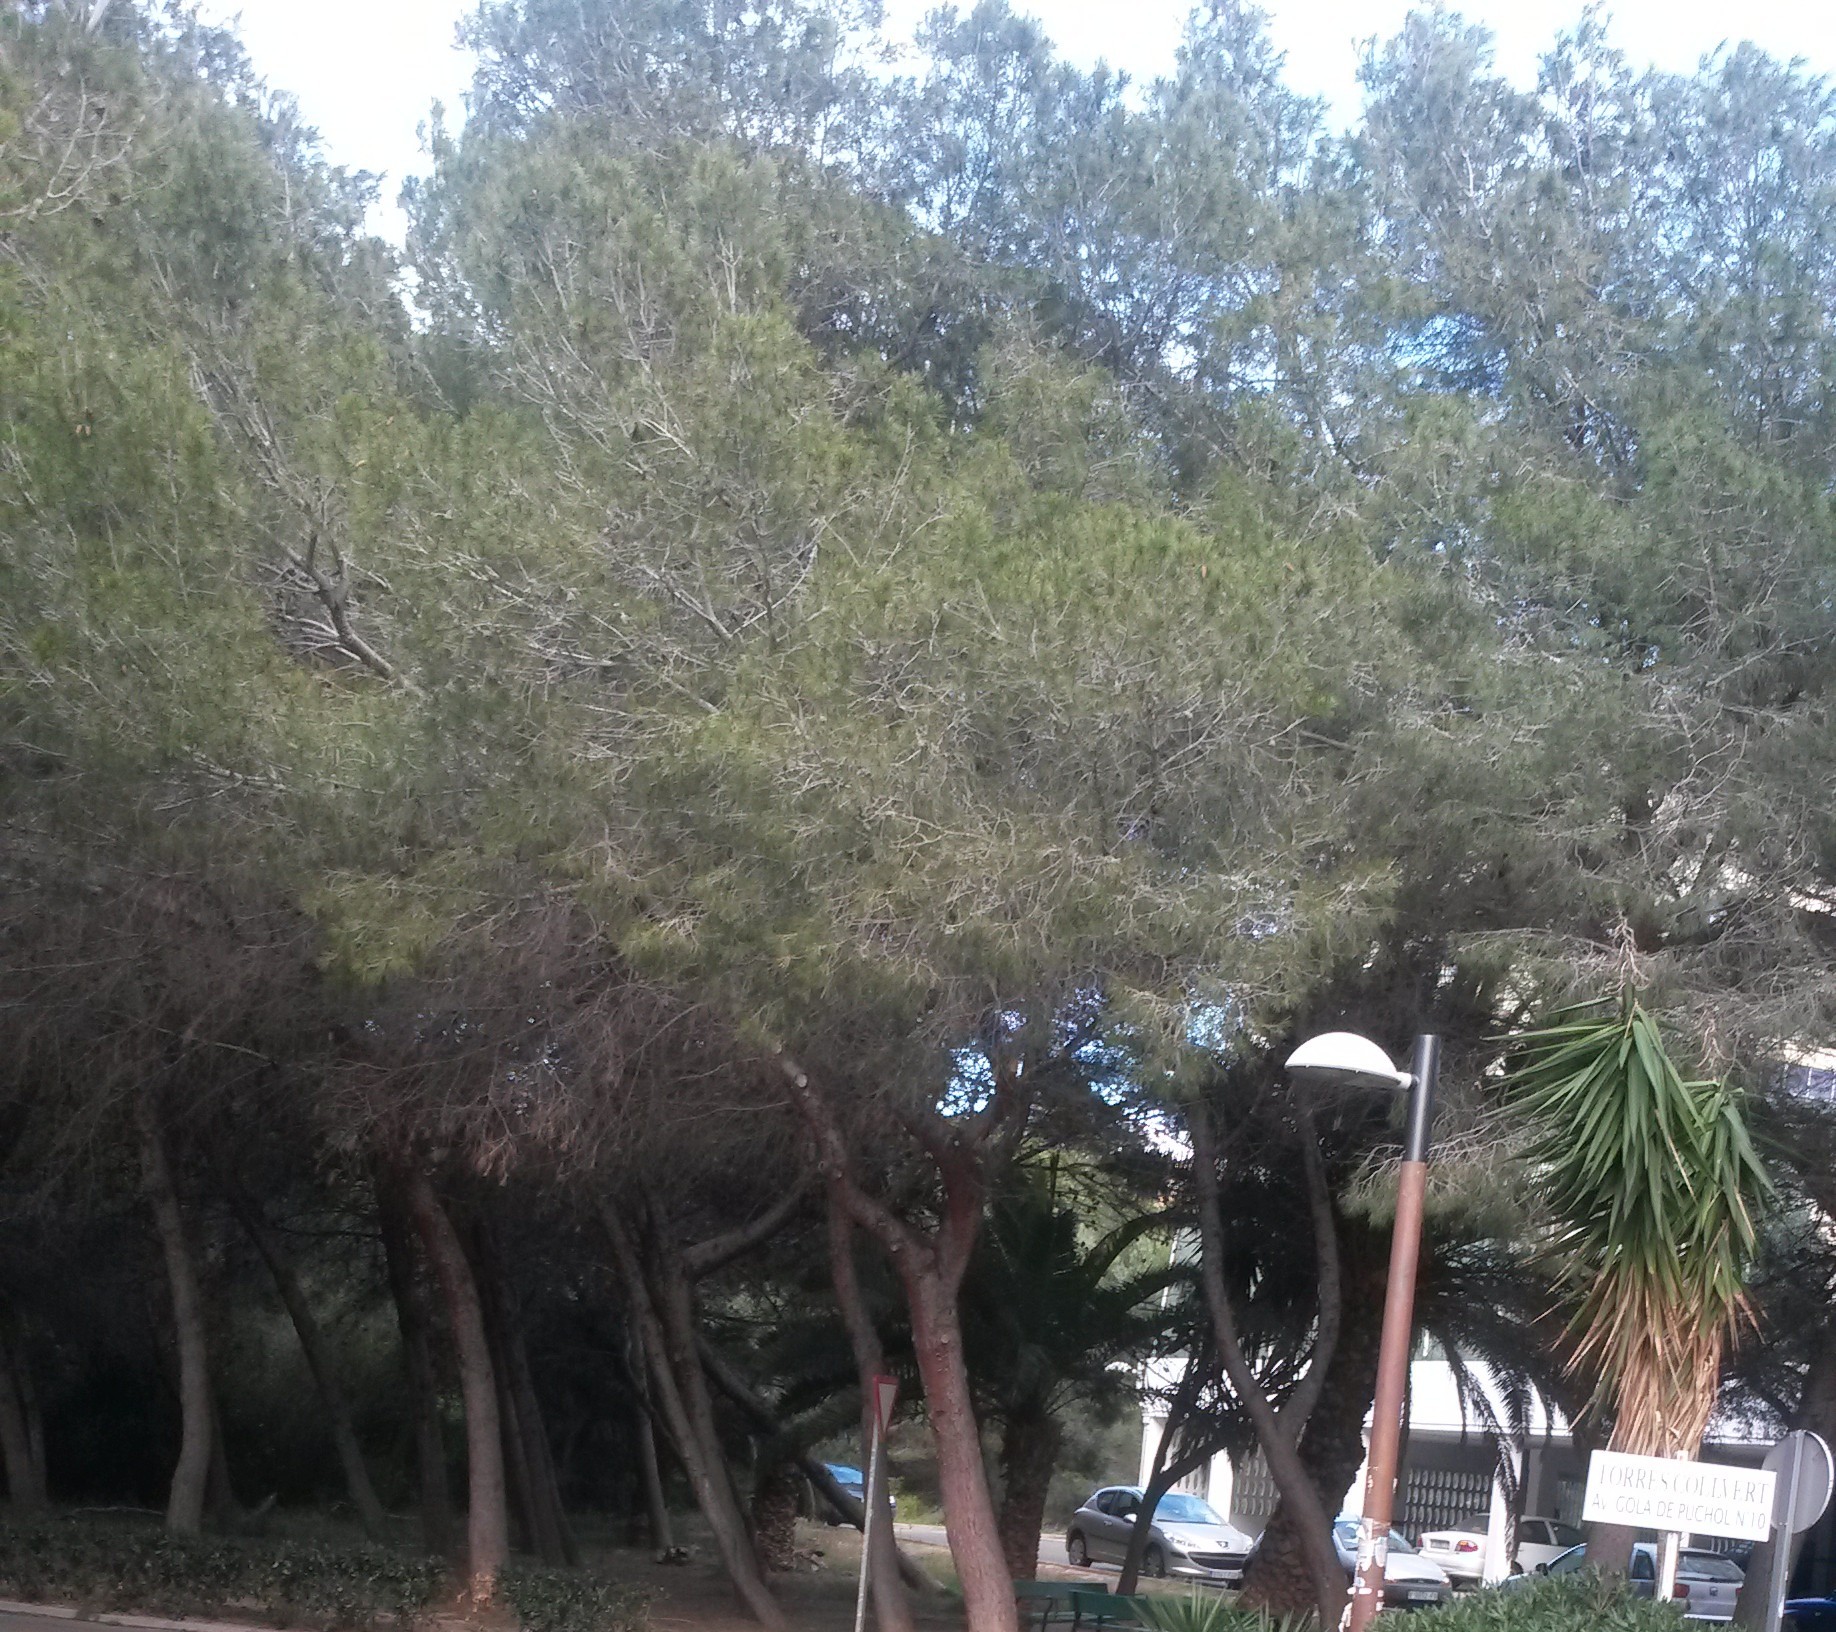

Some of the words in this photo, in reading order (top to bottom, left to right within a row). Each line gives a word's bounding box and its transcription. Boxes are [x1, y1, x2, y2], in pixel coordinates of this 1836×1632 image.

[1599, 1463, 1669, 1491] TORRES
[1656, 1500, 1674, 1519] DE
[1677, 1503, 1731, 1526] PUCHOL
